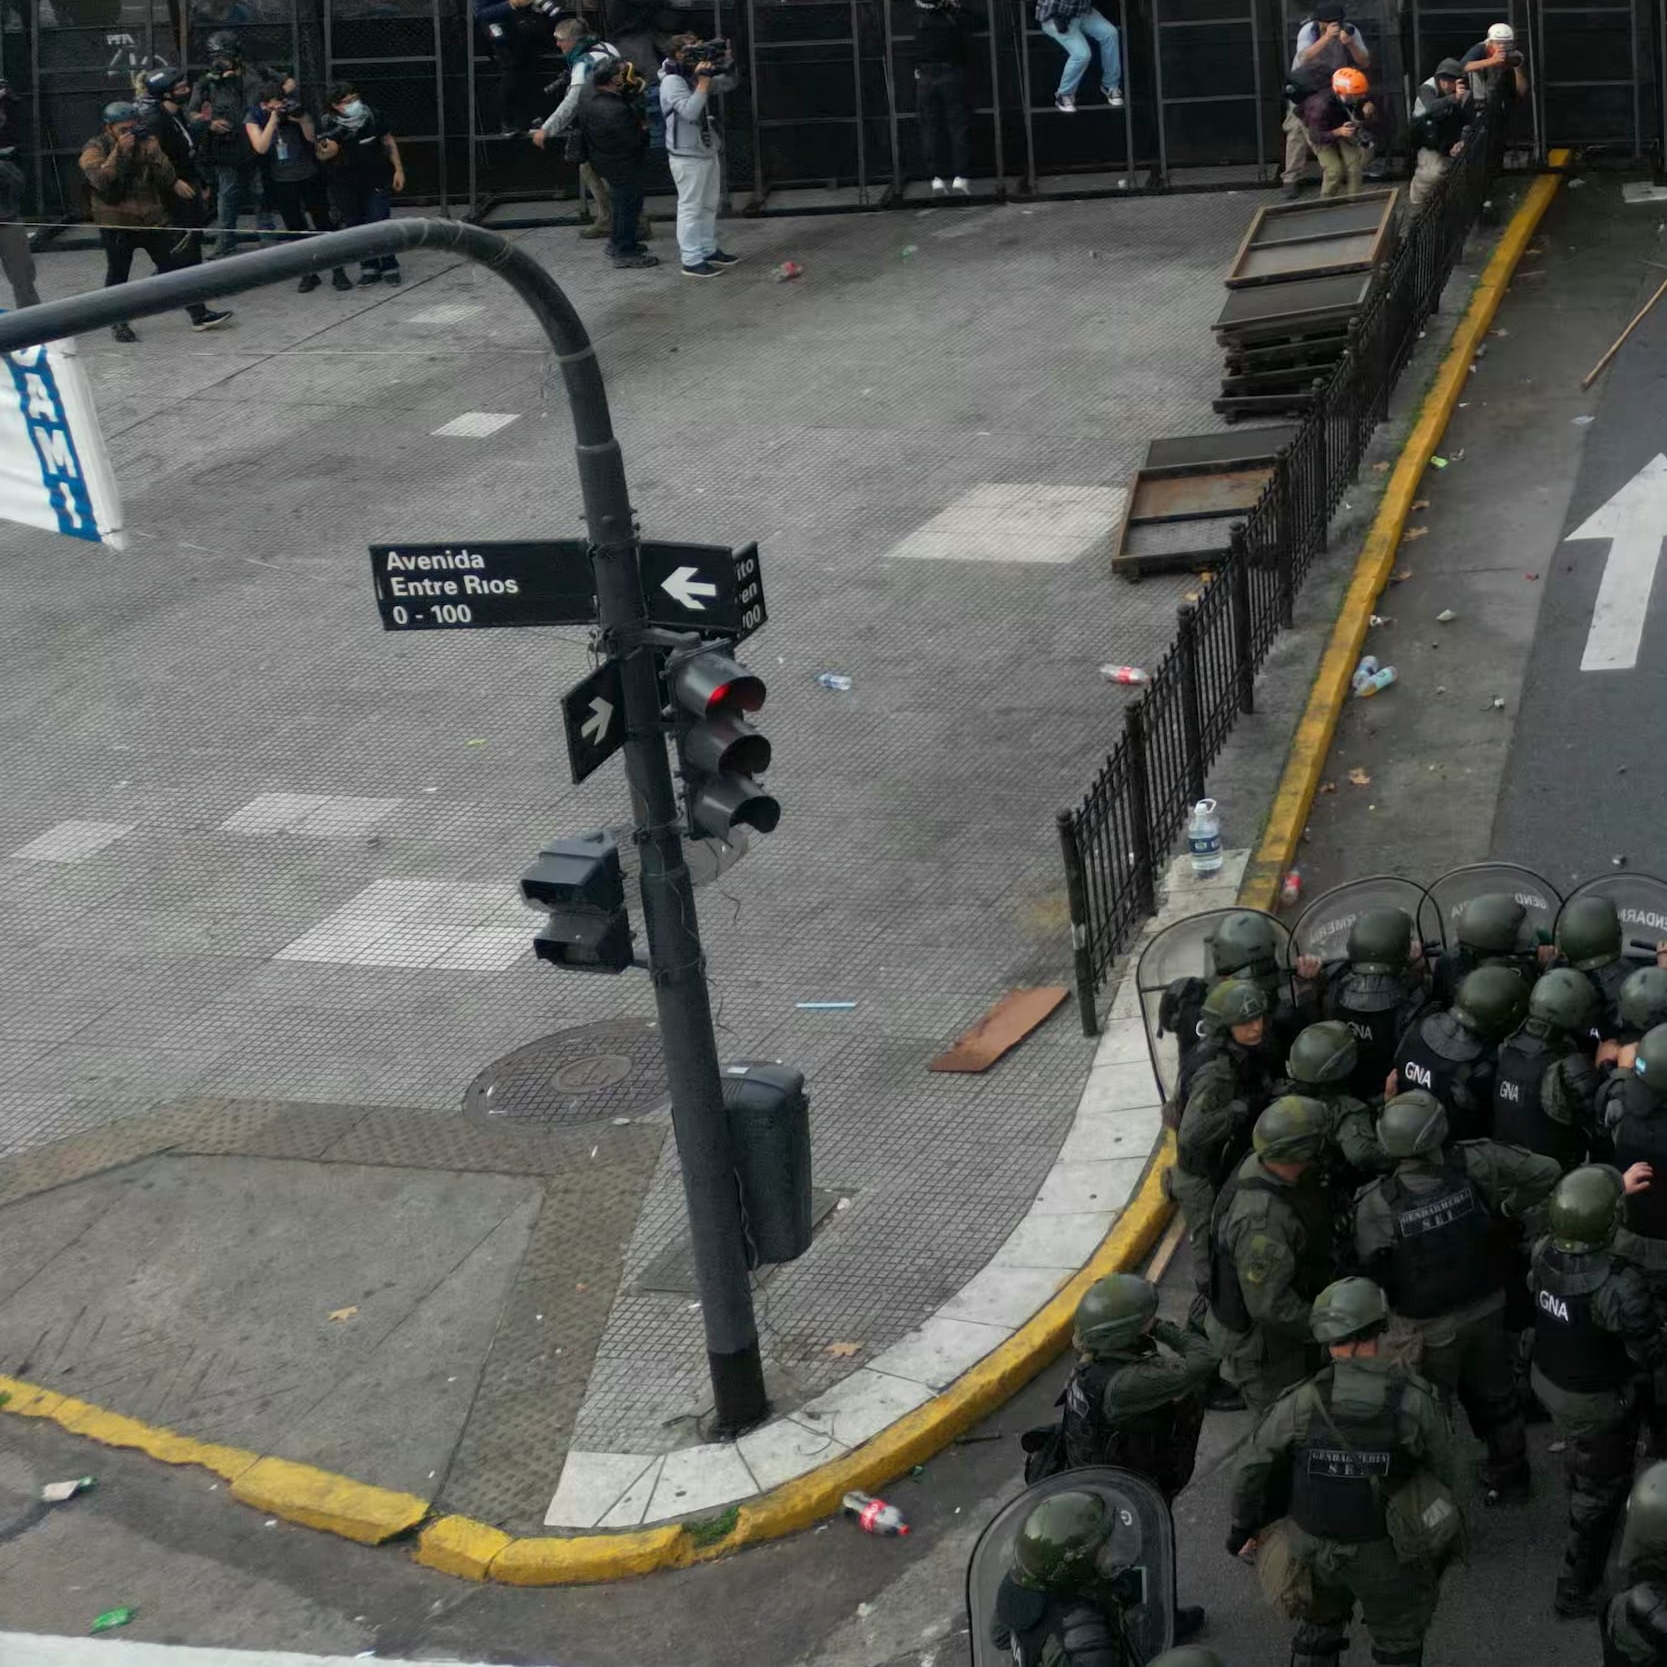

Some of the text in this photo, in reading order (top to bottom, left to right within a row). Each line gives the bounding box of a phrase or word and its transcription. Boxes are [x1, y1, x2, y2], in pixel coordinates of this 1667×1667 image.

[387, 549, 485, 571] Avenida
[390, 577, 458, 597] Entre
[392, 605, 408, 625] 0
[430, 603, 471, 624] 100
[1405, 1062, 1433, 1088] GNA
[1539, 1290, 1569, 1322] GNA
